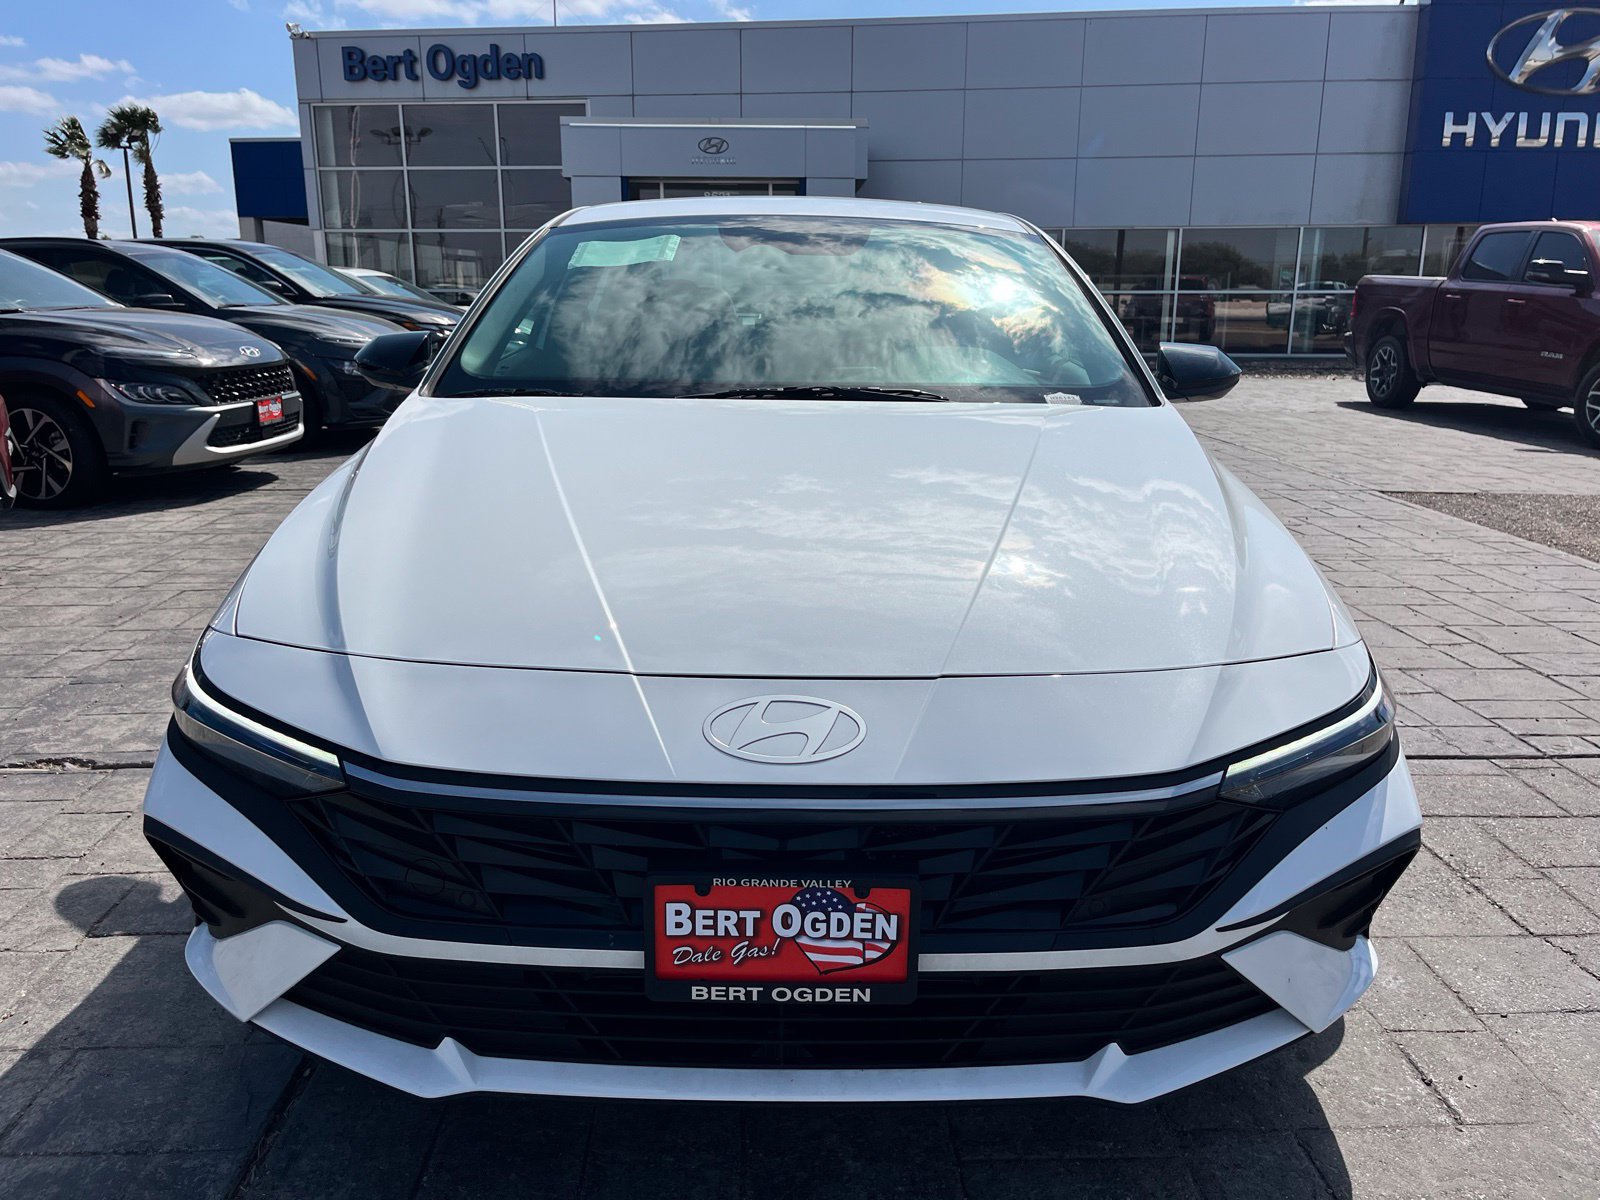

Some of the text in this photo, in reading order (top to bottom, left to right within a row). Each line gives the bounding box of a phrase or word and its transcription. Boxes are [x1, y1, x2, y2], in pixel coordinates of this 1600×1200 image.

[341, 43, 544, 90] Bert Ogden
[1442, 112, 1600, 148] HYUN
[713, 878, 852, 888] RIO GRANDE VALLEY
[665, 902, 898, 941] BERT OGDEN
[672, 938, 780, 965] Dale Gas!
[691, 986, 871, 1003] BERT OGDEN
